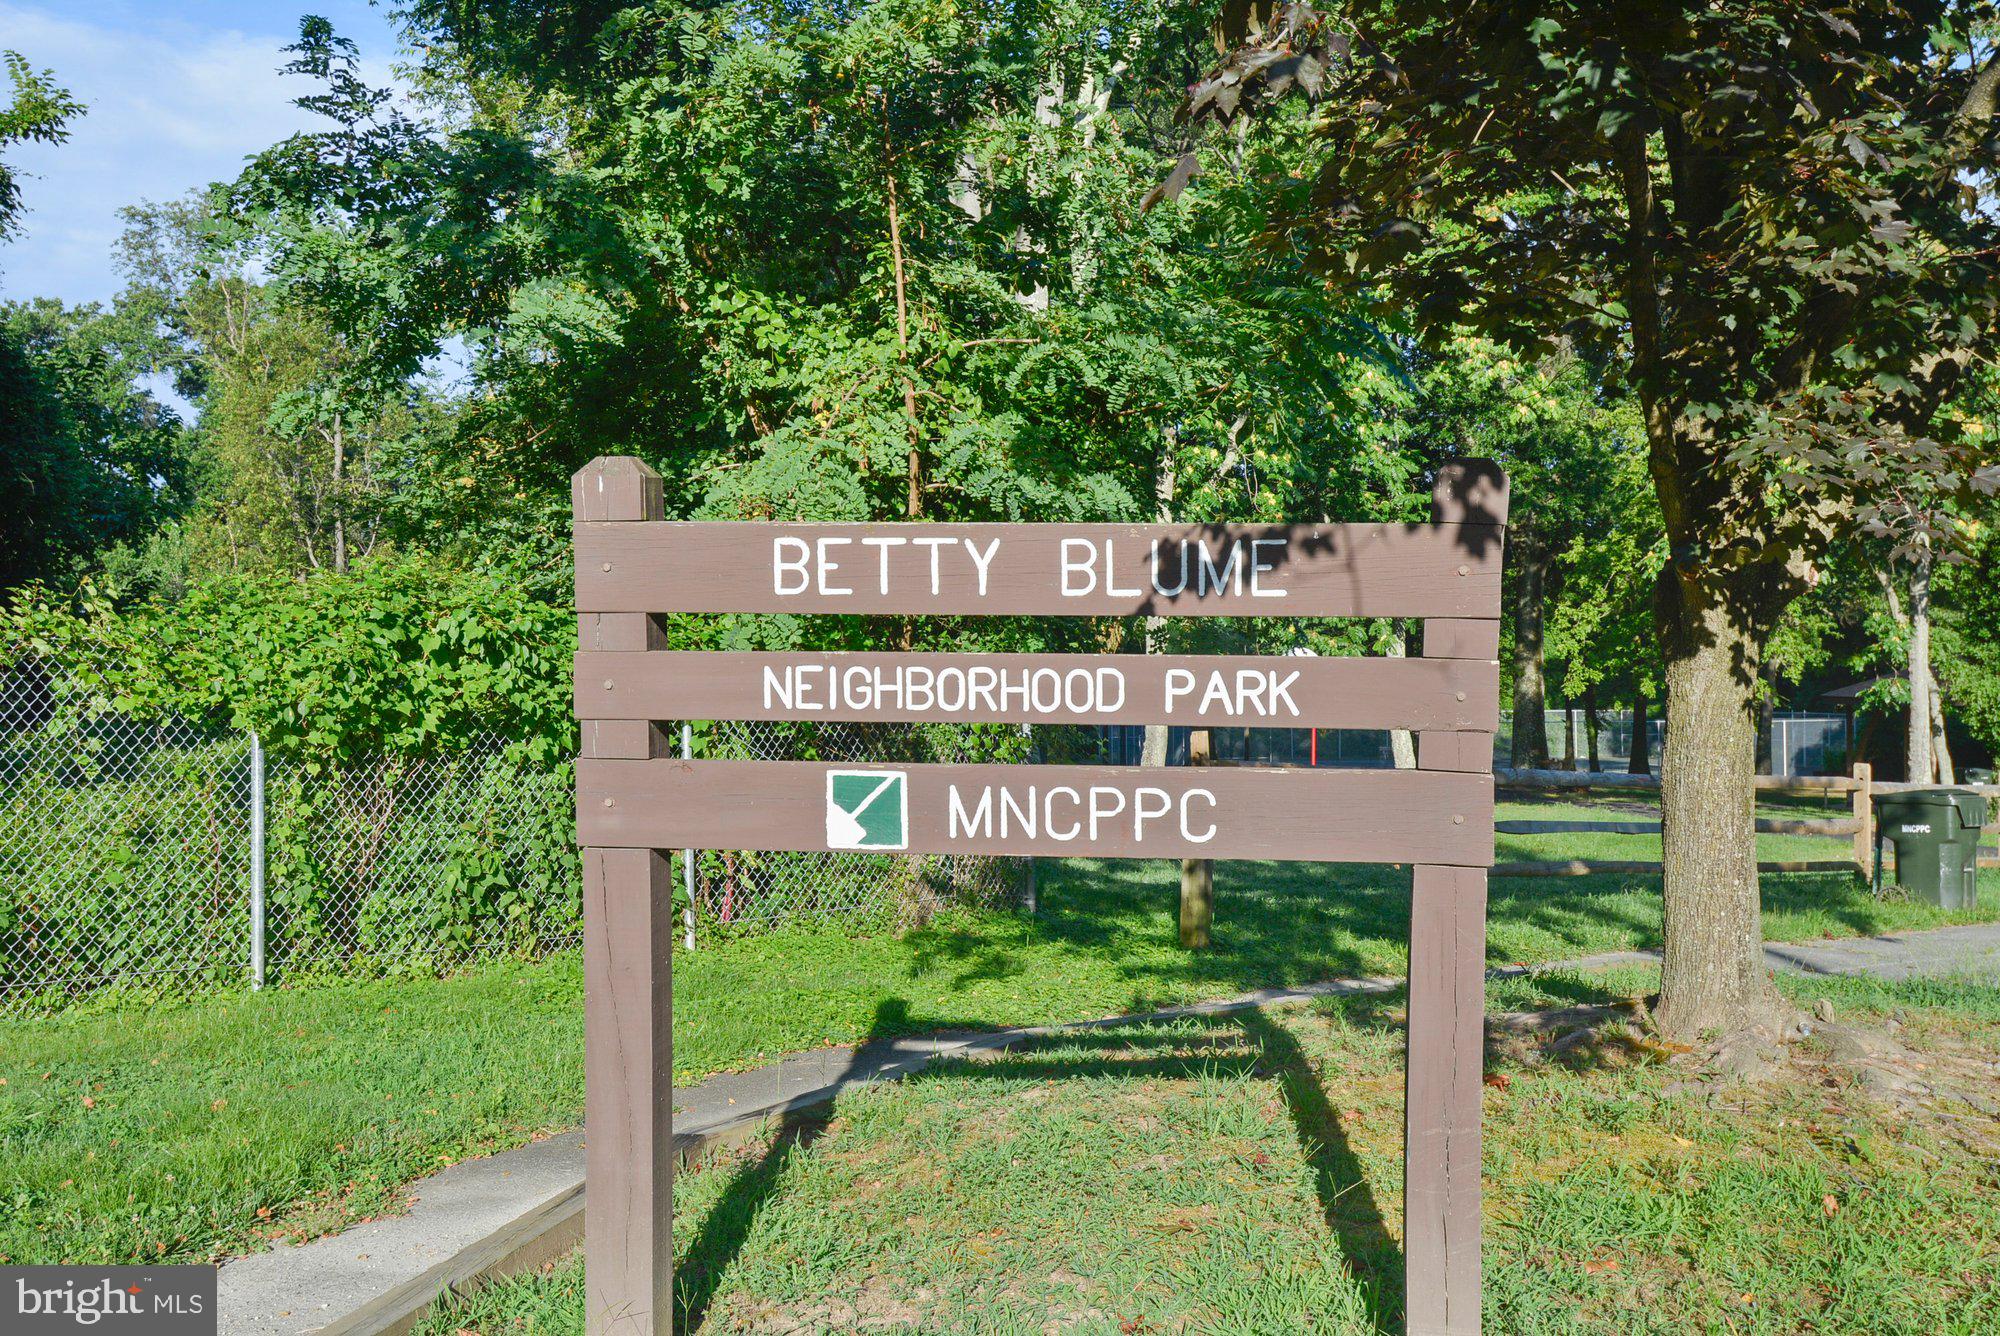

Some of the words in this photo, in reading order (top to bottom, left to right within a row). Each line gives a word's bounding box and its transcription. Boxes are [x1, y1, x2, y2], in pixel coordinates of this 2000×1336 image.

[773, 537, 1002, 596] BETTY
[1060, 537, 1288, 597] BLUME
[762, 666, 1125, 713] NEIGHBORHOOD
[1165, 669, 1301, 717] PARK
[949, 784, 1217, 843] MNCPPC
[1902, 824, 1931, 833] MNCPPC
